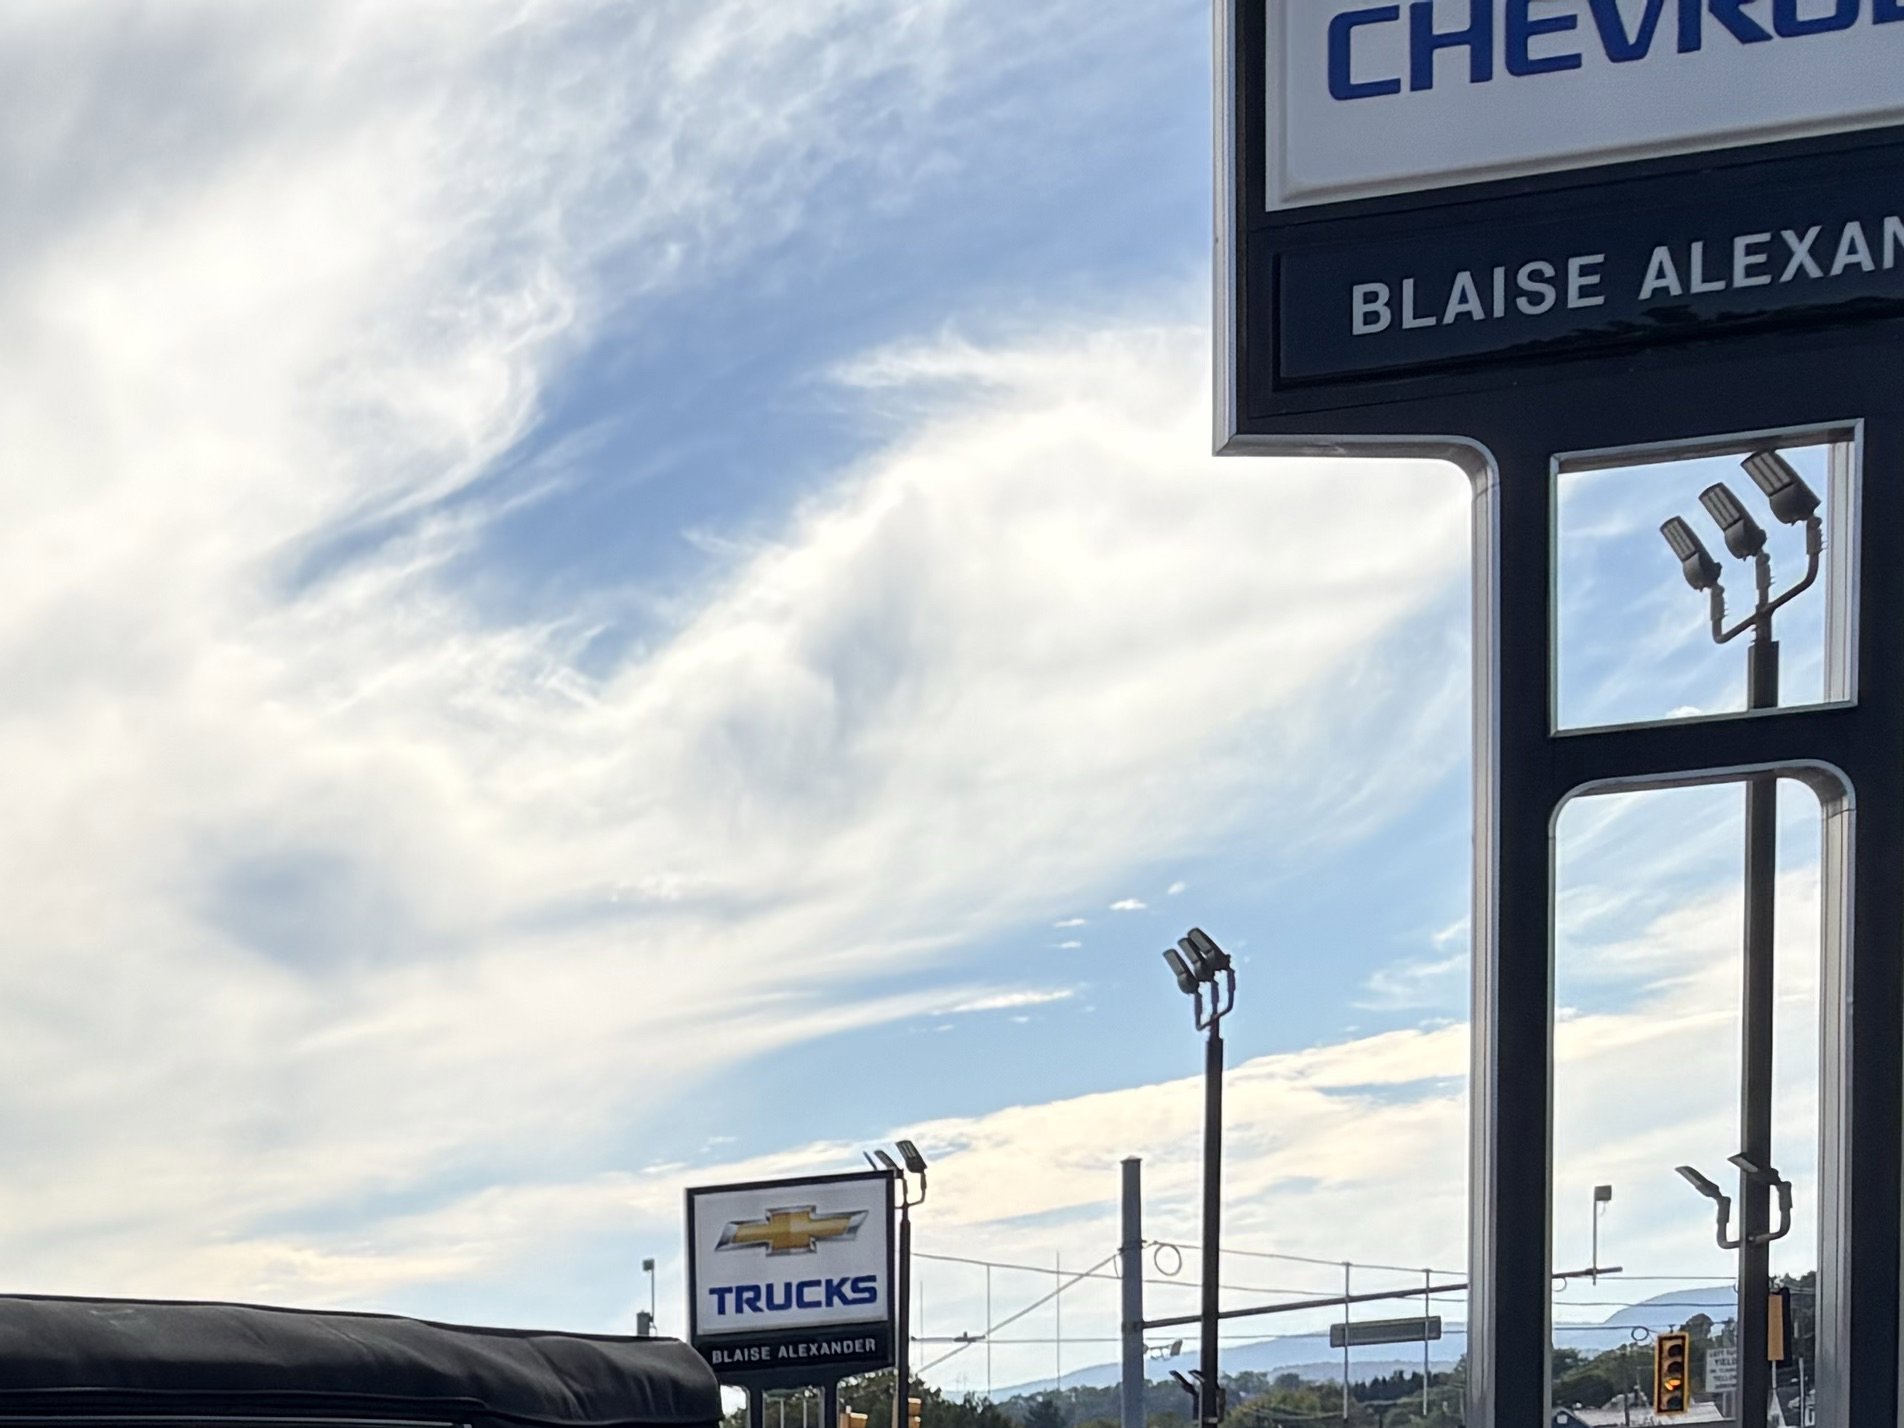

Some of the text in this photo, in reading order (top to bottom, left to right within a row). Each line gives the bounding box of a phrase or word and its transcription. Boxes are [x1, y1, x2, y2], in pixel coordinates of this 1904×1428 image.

[1328, 0, 1904, 100] CHEVR
[1351, 253, 1606, 336] BLAISE
[709, 1275, 877, 1315] TRUCKS
[712, 1338, 876, 1364] BLAISE ALEXANDER
